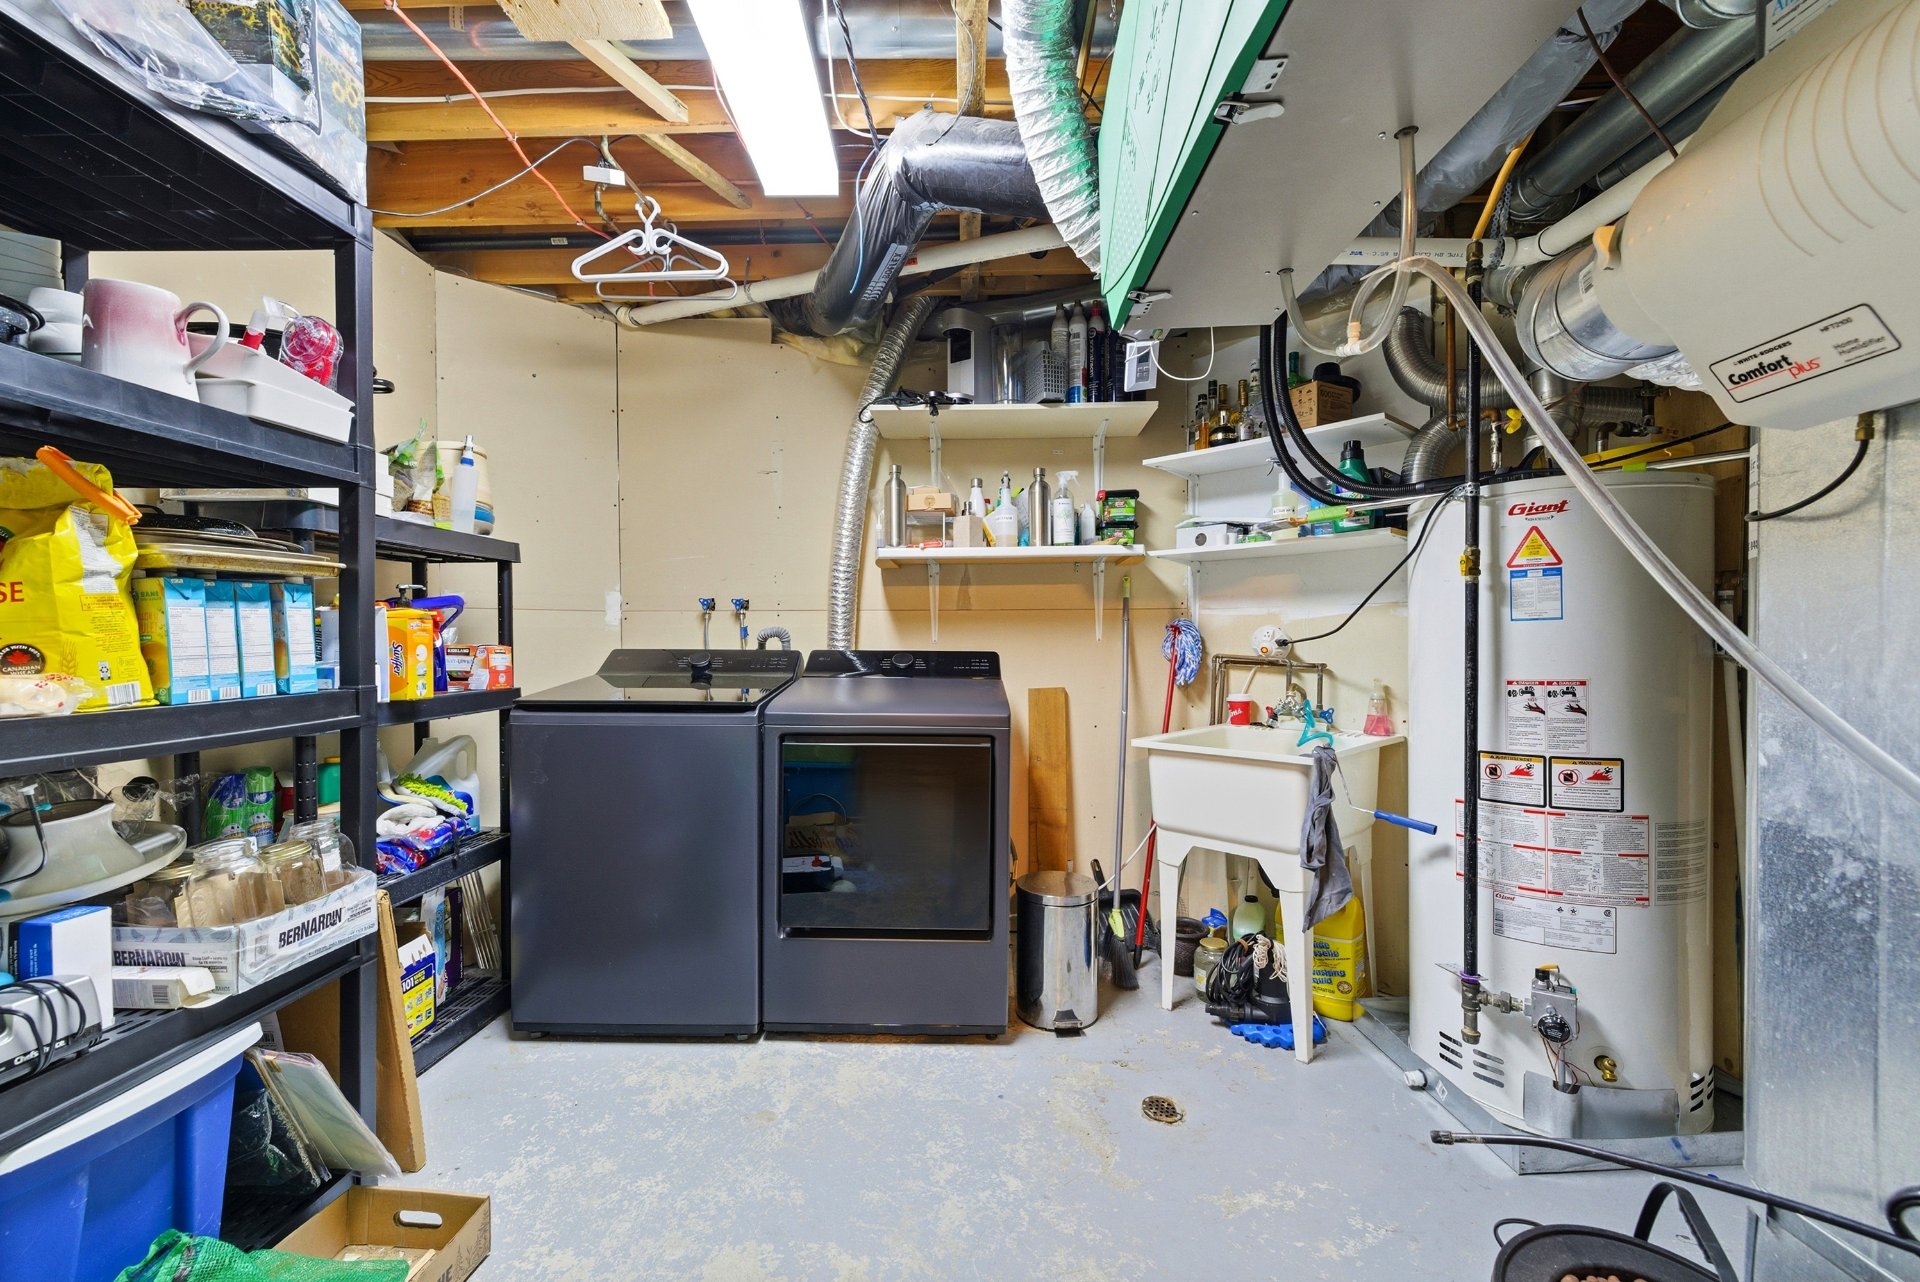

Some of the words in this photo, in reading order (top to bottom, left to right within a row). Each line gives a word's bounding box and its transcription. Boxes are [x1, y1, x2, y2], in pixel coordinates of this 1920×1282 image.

[1737, 340, 1792, 366] WHITE-RODGERS
[1728, 354, 1793, 386] Comfort
[1787, 358, 1820, 379] plus
[1508, 499, 1570, 517] Giant
[2, 665, 41, 673] CANADIAN
[390, 640, 404, 677] Swiffer
[279, 907, 344, 949] BERNARDIN
[114, 949, 186, 967] BERNARDIN
[401, 977, 414, 992] 101
